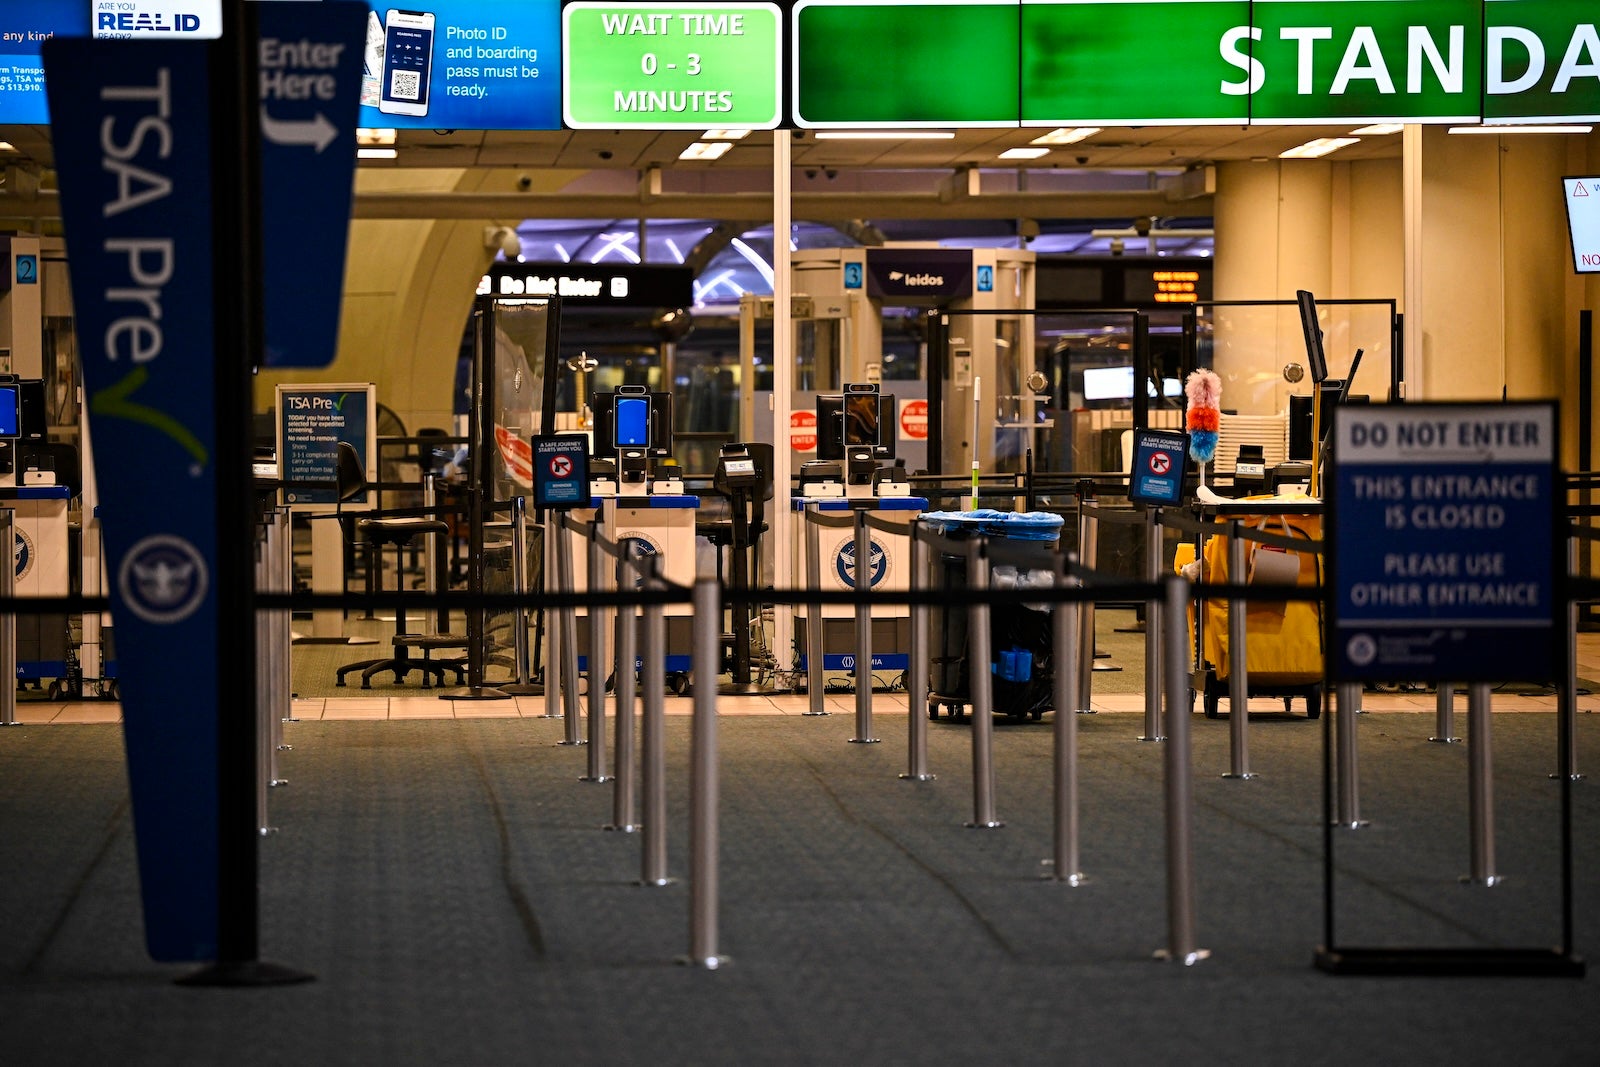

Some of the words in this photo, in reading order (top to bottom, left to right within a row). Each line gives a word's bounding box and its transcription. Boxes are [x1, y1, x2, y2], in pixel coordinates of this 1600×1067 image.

[98, 2, 115, 10] ARE
[116, 2, 135, 10] YOU
[98, 12, 170, 31] REAL
[174, 13, 200, 31] ID
[601, 13, 673, 36] WAIT
[678, 13, 745, 36] TIME
[3, 31, 24, 43] any
[446, 27, 487, 41] Photo
[491, 27, 507, 40] ID
[258, 38, 345, 69] Enter
[446, 47, 472, 59] and
[477, 46, 538, 62] boarding
[1219, 23, 1600, 96] STANDA
[446, 67, 479, 80] pass
[484, 65, 518, 78] must
[522, 65, 539, 78] be
[641, 53, 658, 76] 0
[687, 53, 702, 76] 3
[7, 83, 42, 92] $13,910.
[16, 75, 32, 83] TSA
[258, 70, 336, 100] Here
[446, 83, 489, 99] ready.
[613, 90, 734, 113] MINUTES
[101, 67, 173, 217] TSA
[20, 259, 33, 281] 2
[848, 265, 858, 284] 3
[979, 269, 989, 290] 4
[904, 273, 944, 287] leidos
[104, 238, 174, 362] Pre
[288, 397, 310, 409] TSA
[313, 397, 332, 409] Pre
[306, 415, 317, 423] you
[318, 421, 345, 429] expedited
[791, 436, 815, 445] ENTER
[1350, 421, 1389, 448] DO
[1397, 421, 1449, 448] NOT
[1457, 421, 1540, 448] ENTER
[306, 452, 329, 460] compliant
[292, 466, 310, 474] Laptop
[323, 466, 334, 474] bag
[1351, 474, 1405, 499] THIS
[1410, 474, 1539, 499] ENTRANCE
[1384, 504, 1406, 528] IS
[1411, 503, 1506, 529] CLOSED
[1384, 552, 1459, 577] PLEASE
[1464, 552, 1505, 577] USE
[1350, 582, 1423, 607] OTHER
[1427, 582, 1539, 607] ENTRANCE
